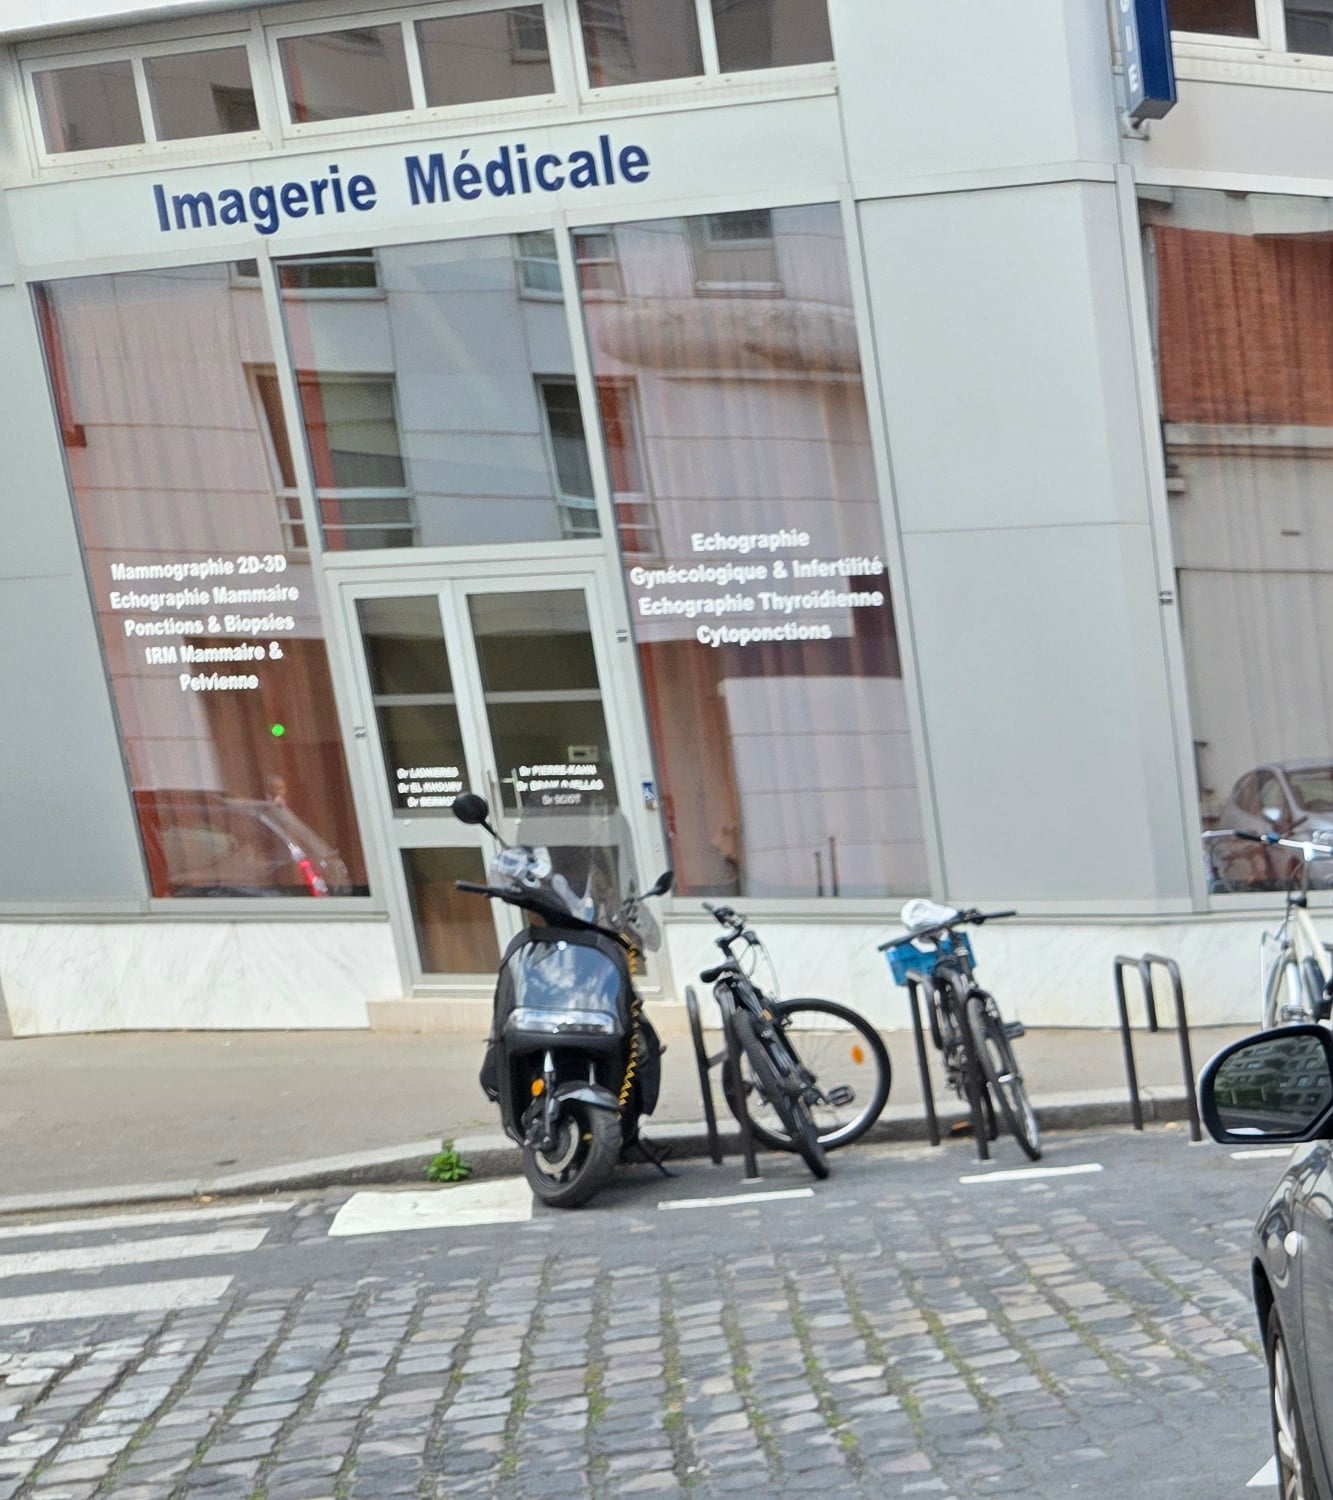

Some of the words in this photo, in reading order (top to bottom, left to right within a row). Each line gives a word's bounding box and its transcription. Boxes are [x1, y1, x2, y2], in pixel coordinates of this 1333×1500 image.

[153, 164, 377, 235] Imagerie
[405, 134, 650, 206] Médicale
[691, 528, 810, 553] Echographie
[110, 557, 234, 581] Mammographie
[237, 554, 287, 575] 2D-3D
[630, 562, 768, 588] Gynécologique
[772, 560, 788, 579] &
[792, 555, 884, 578] Infertilité
[109, 587, 210, 611] Echographie
[212, 584, 299, 604] Mammaire
[638, 593, 755, 617] Echographie
[124, 617, 204, 637] Ponctions
[207, 615, 221, 633] &
[224, 613, 295, 635] Biopsies
[696, 622, 832, 647] Cytoponctions
[145, 646, 178, 664] IRM
[179, 643, 265, 664] Mammaire
[268, 641, 284, 660] &
[179, 672, 259, 691] Pelvienne
